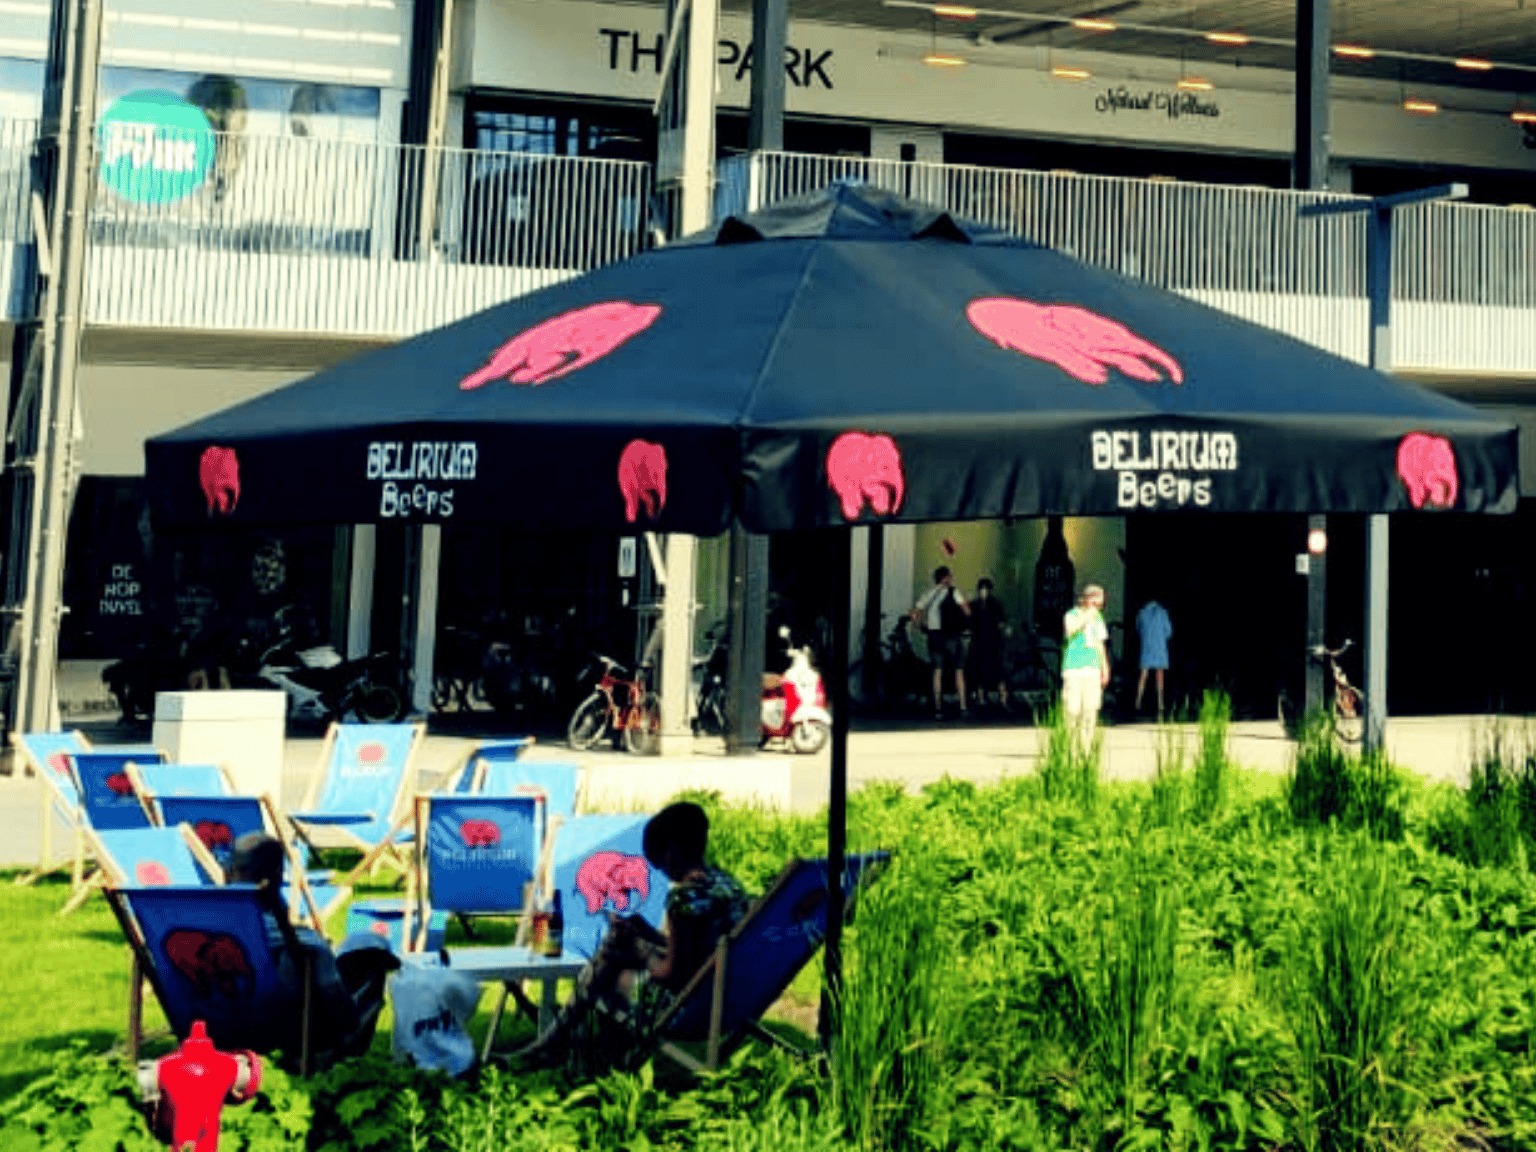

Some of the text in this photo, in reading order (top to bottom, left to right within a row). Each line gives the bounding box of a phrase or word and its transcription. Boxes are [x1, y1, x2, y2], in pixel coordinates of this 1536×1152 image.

[599, 28, 664, 74] TH
[366, 441, 478, 480] DELIRIUM
[1091, 430, 1238, 471] DELIRIUM
[1117, 470, 1213, 509] Beers
